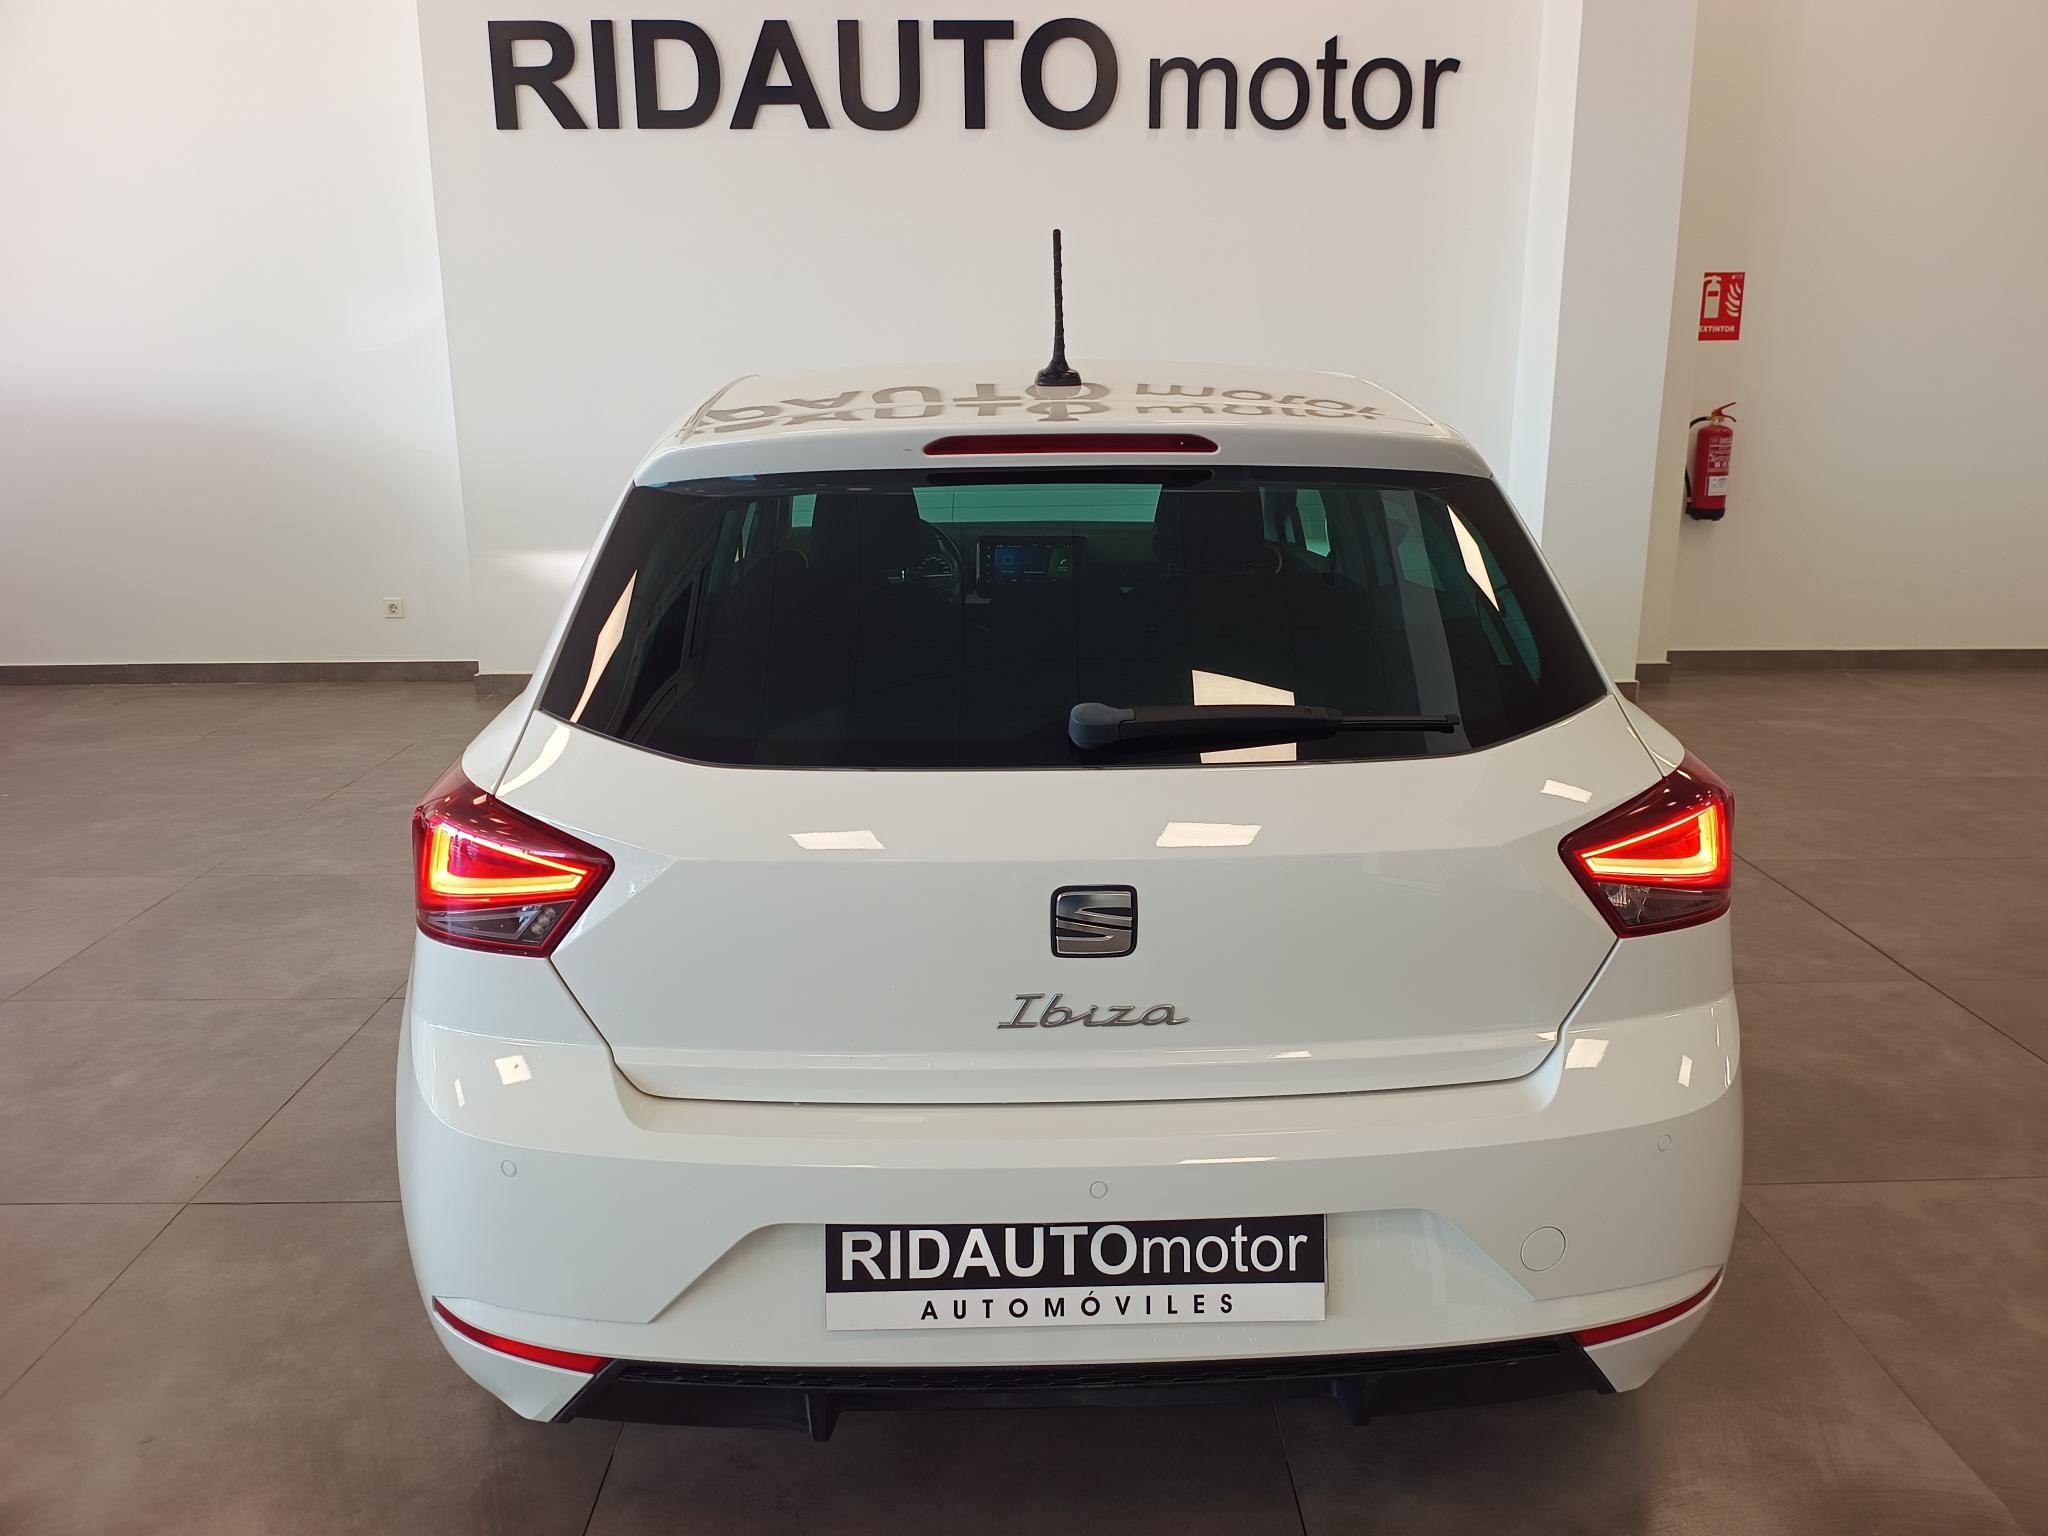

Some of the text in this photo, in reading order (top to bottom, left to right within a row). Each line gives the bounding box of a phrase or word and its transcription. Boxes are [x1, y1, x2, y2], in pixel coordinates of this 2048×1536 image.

[488, 18, 1461, 131] RIDAUTO motor
[997, 992, 1190, 1029] Ibiza
[841, 1224, 1309, 1281] RIDAUTOmotor
[920, 1290, 1234, 1321] AUTOMÓVILES
